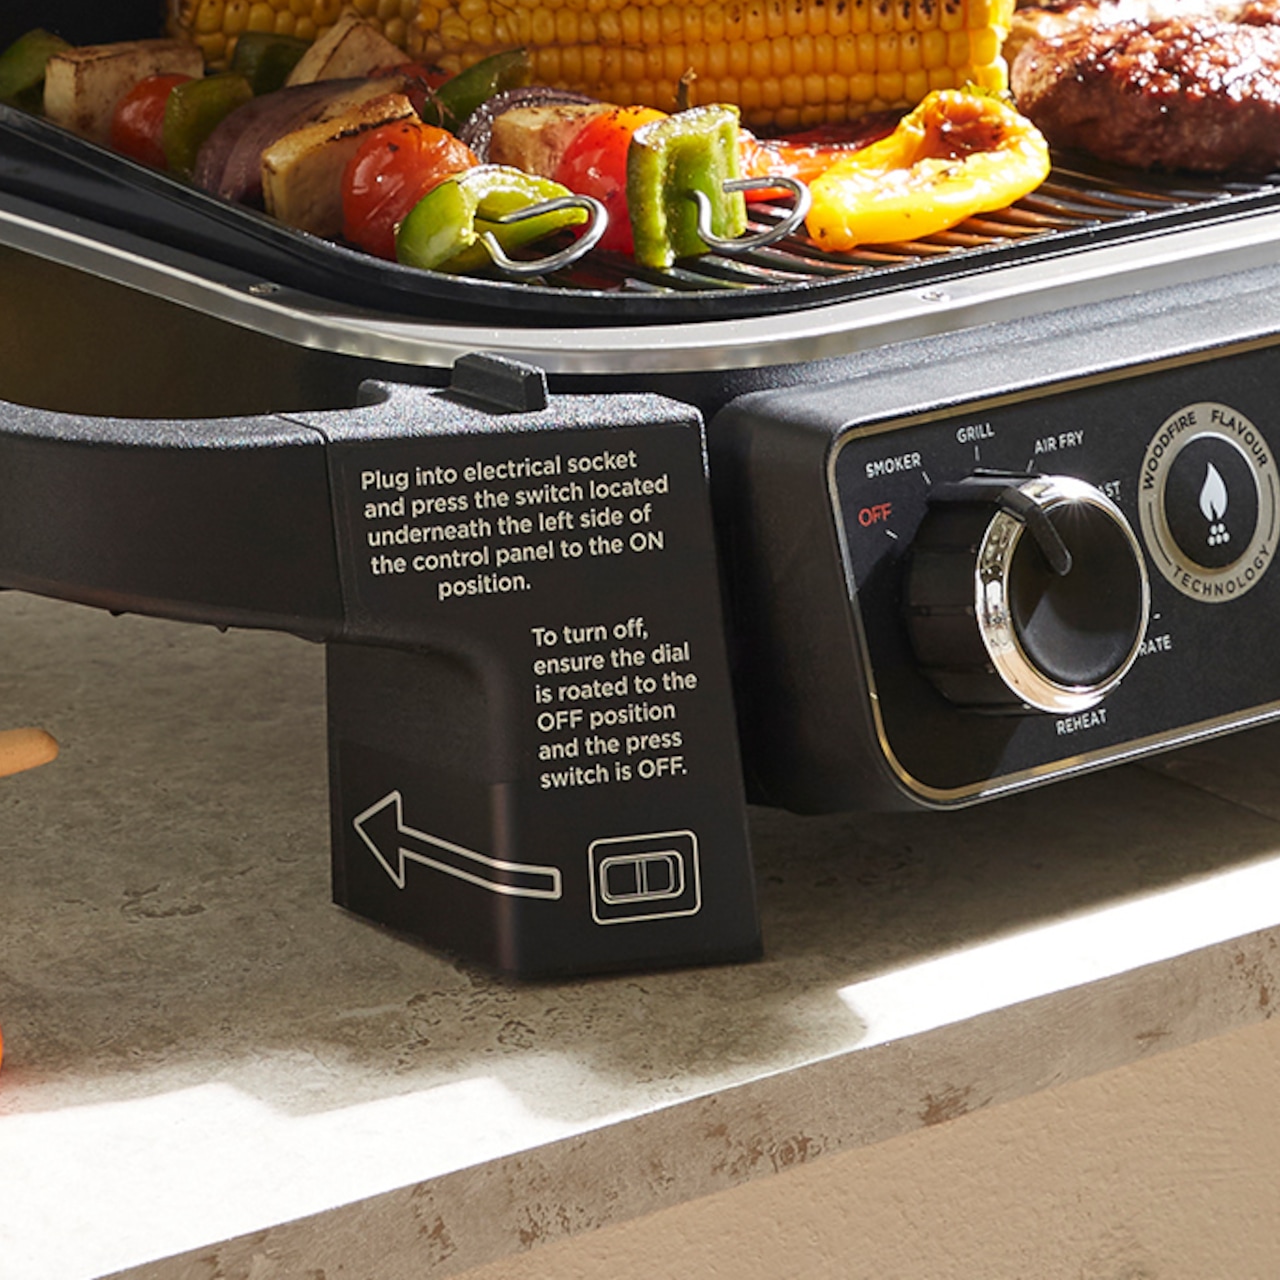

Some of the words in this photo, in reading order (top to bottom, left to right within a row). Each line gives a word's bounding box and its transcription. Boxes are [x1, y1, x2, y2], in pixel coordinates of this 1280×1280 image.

[956, 422, 995, 445] GRILL
[1034, 436, 1057, 455] AIR
[1059, 430, 1085, 450] FRY
[1143, 411, 1197, 490] WOODFIRE
[1211, 409, 1269, 468] FLAVOUR
[361, 469, 409, 492] Plug
[415, 466, 458, 486] into
[463, 455, 561, 483] electrical
[567, 450, 638, 474] socket
[864, 452, 921, 479] SMOKER
[364, 496, 405, 519] and
[411, 495, 469, 519] press
[473, 489, 510, 509] the
[515, 481, 584, 506] switch
[589, 473, 669, 500] located
[367, 517, 492, 547] underneath
[497, 515, 533, 536] the
[538, 510, 574, 532] left
[579, 506, 624, 528] side
[629, 502, 652, 524] of
[858, 503, 893, 528] OFF
[370, 554, 407, 575] the
[412, 545, 490, 572] control
[495, 539, 555, 568] panel
[560, 540, 583, 558] to
[588, 535, 624, 556] the
[629, 530, 664, 552] ON
[438, 572, 531, 601] position.
[1173, 544, 1270, 597] TECHNOLOGY
[531, 627, 558, 647] To
[562, 625, 608, 644] turn
[612, 617, 649, 640] off,
[533, 654, 606, 676] ensure
[610, 647, 646, 668] the
[651, 641, 690, 665] dial
[535, 684, 553, 704] is
[558, 675, 628, 702] roated
[633, 675, 657, 694] to
[661, 671, 698, 691] the
[537, 708, 583, 732] OFF
[589, 701, 676, 731] position
[1056, 709, 1107, 735] REHEAT
[538, 737, 579, 761] and
[584, 735, 620, 756] the
[625, 731, 683, 755] press
[540, 763, 610, 789] switch
[614, 761, 632, 781] is
[637, 755, 687, 779] OFF.
